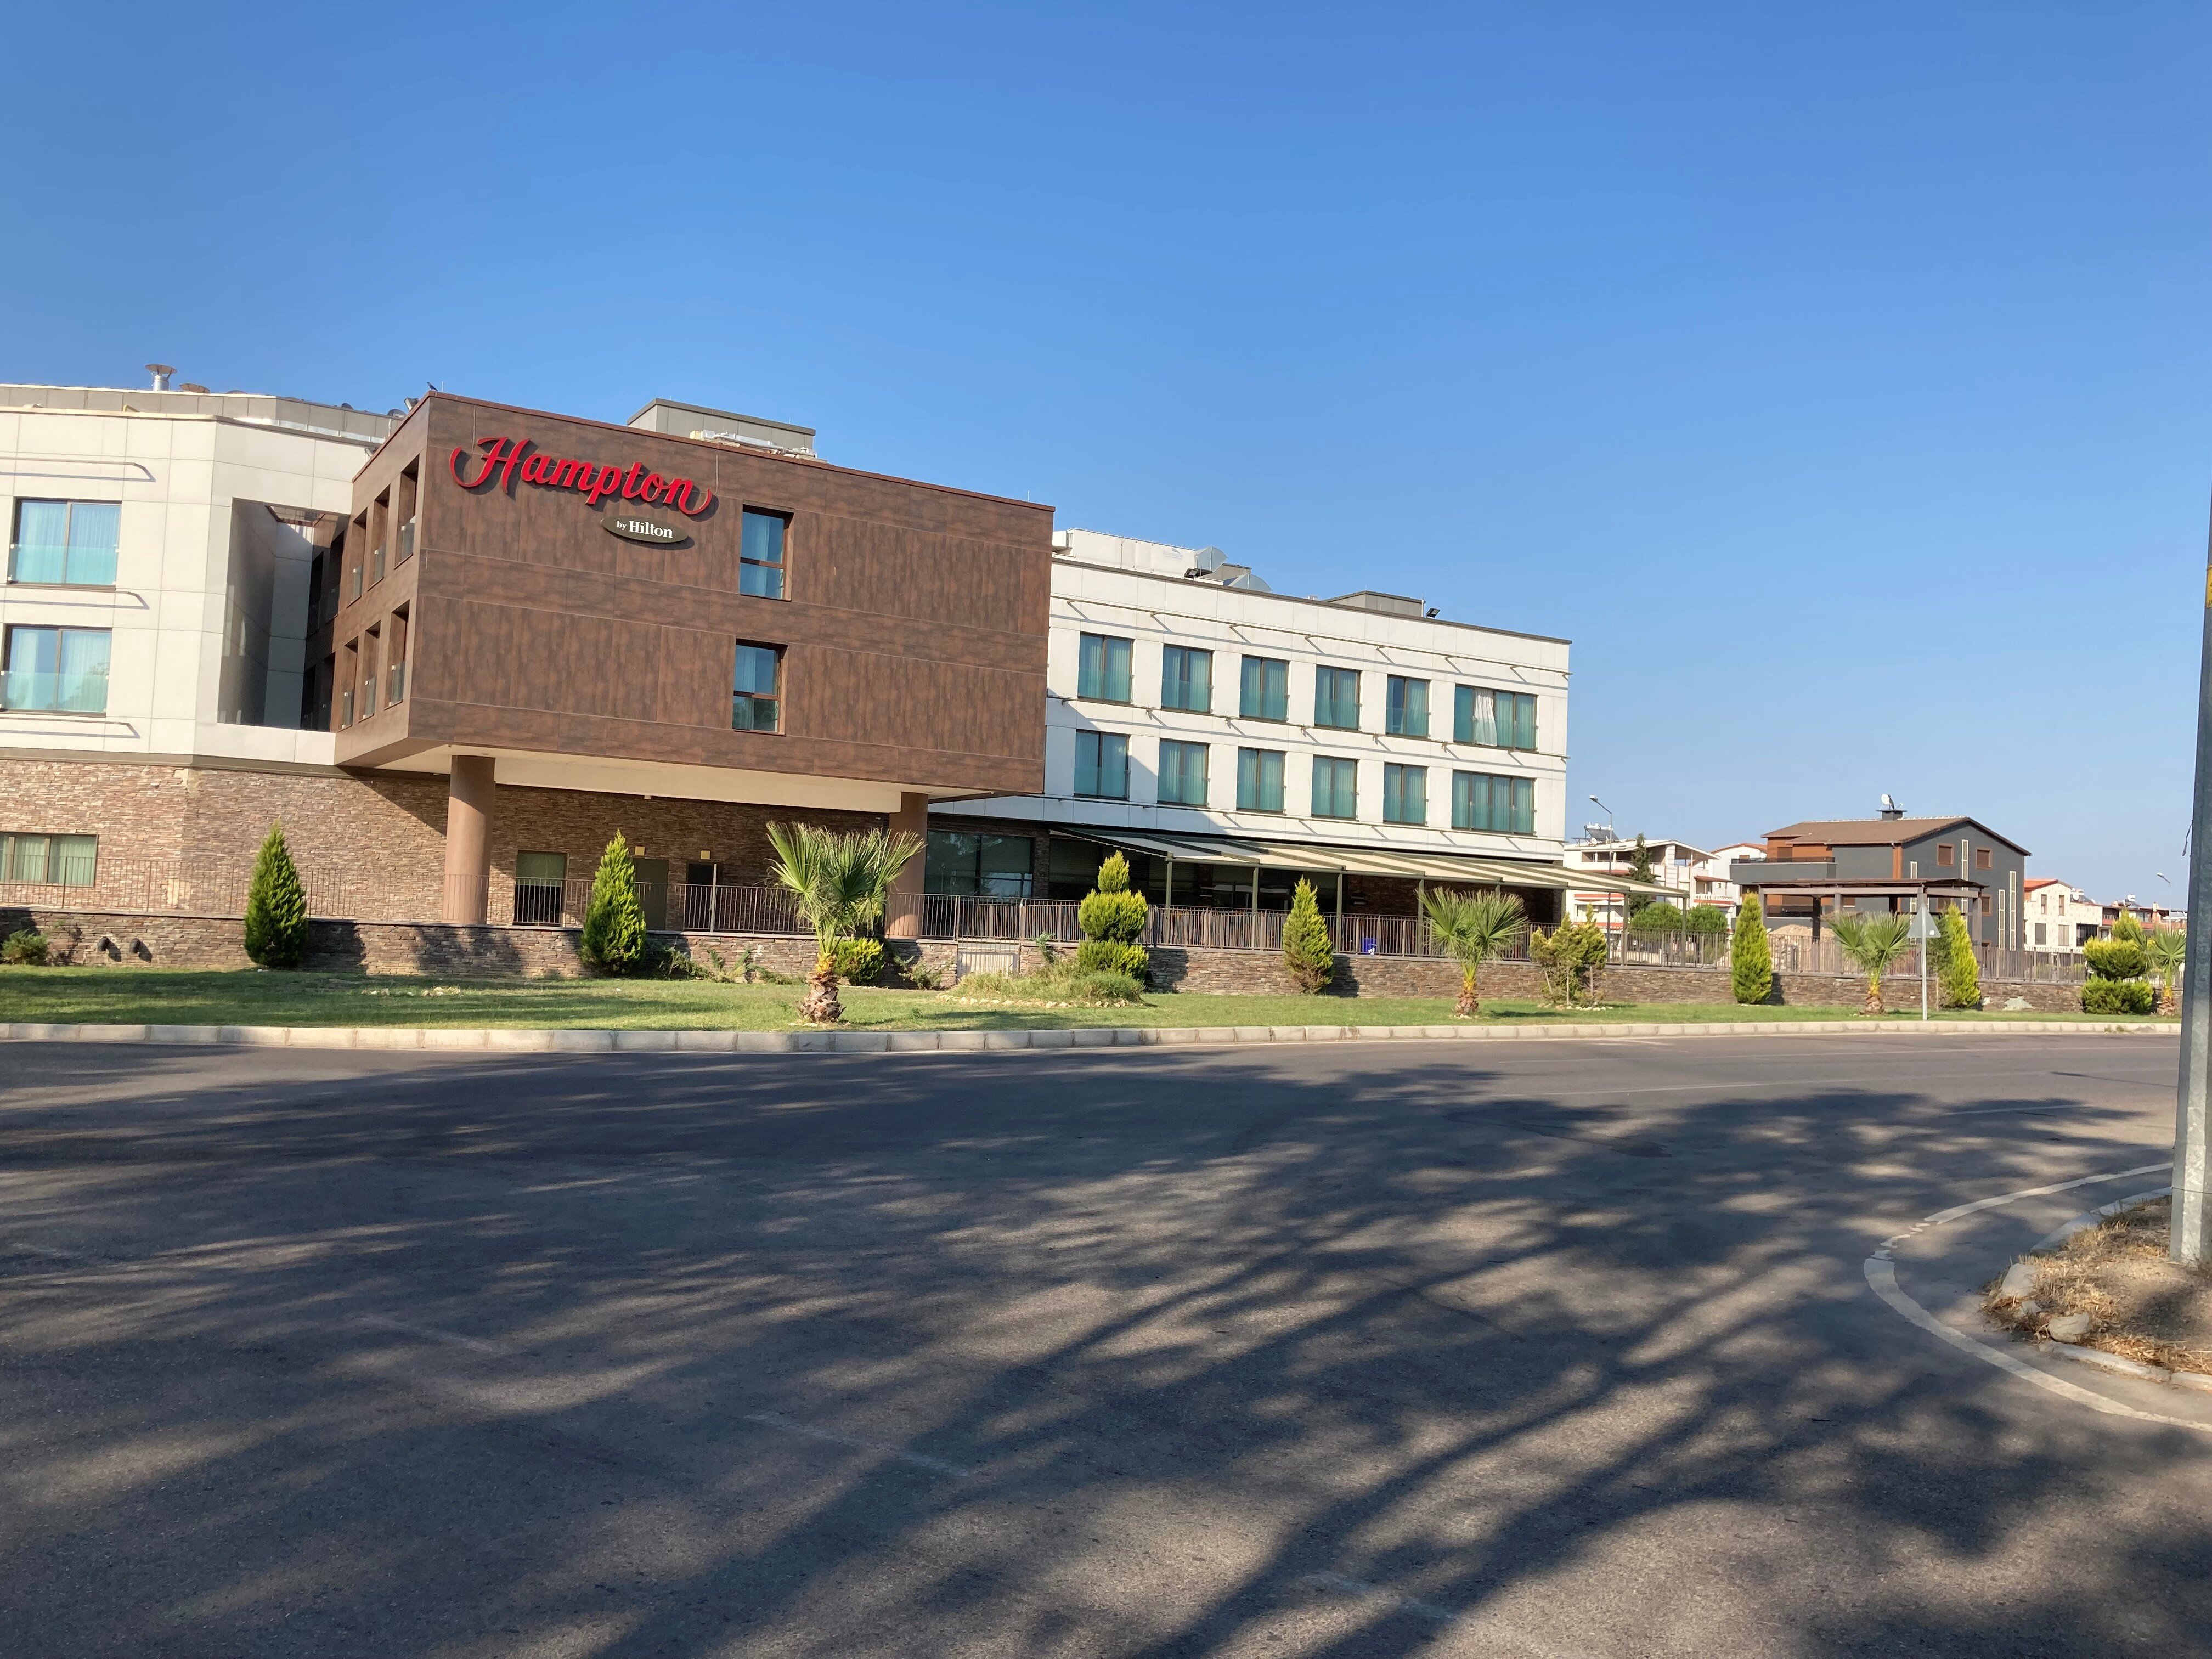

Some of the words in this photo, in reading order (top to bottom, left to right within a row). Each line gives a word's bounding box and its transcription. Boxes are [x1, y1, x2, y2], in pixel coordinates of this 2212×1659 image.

[449, 437, 712, 515] Hampton
[617, 521, 627, 531] by
[629, 521, 673, 538] Hilton
